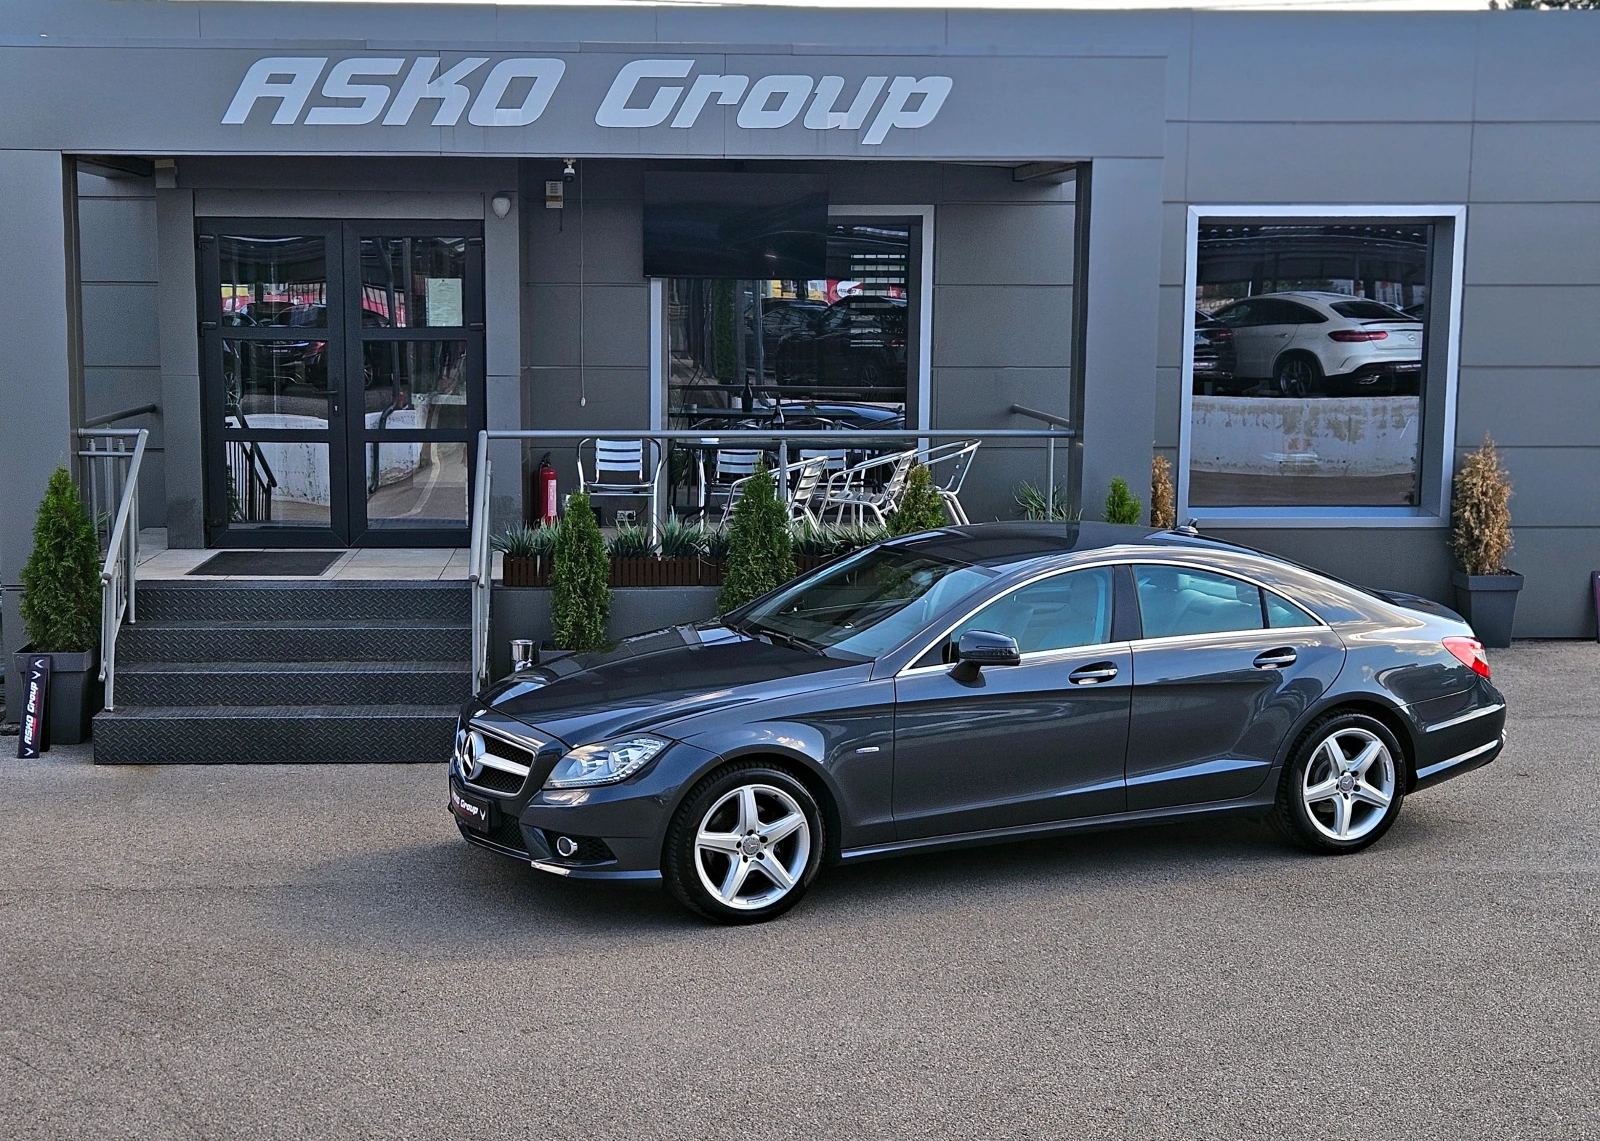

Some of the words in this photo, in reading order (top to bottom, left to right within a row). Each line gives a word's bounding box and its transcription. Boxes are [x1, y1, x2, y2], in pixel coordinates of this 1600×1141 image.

[220, 57, 566, 127] ASKO
[594, 59, 953, 144] Group
[27, 681, 38, 713] Group
[24, 714, 34, 745] ASKO
[460, 799, 479, 815] Group
